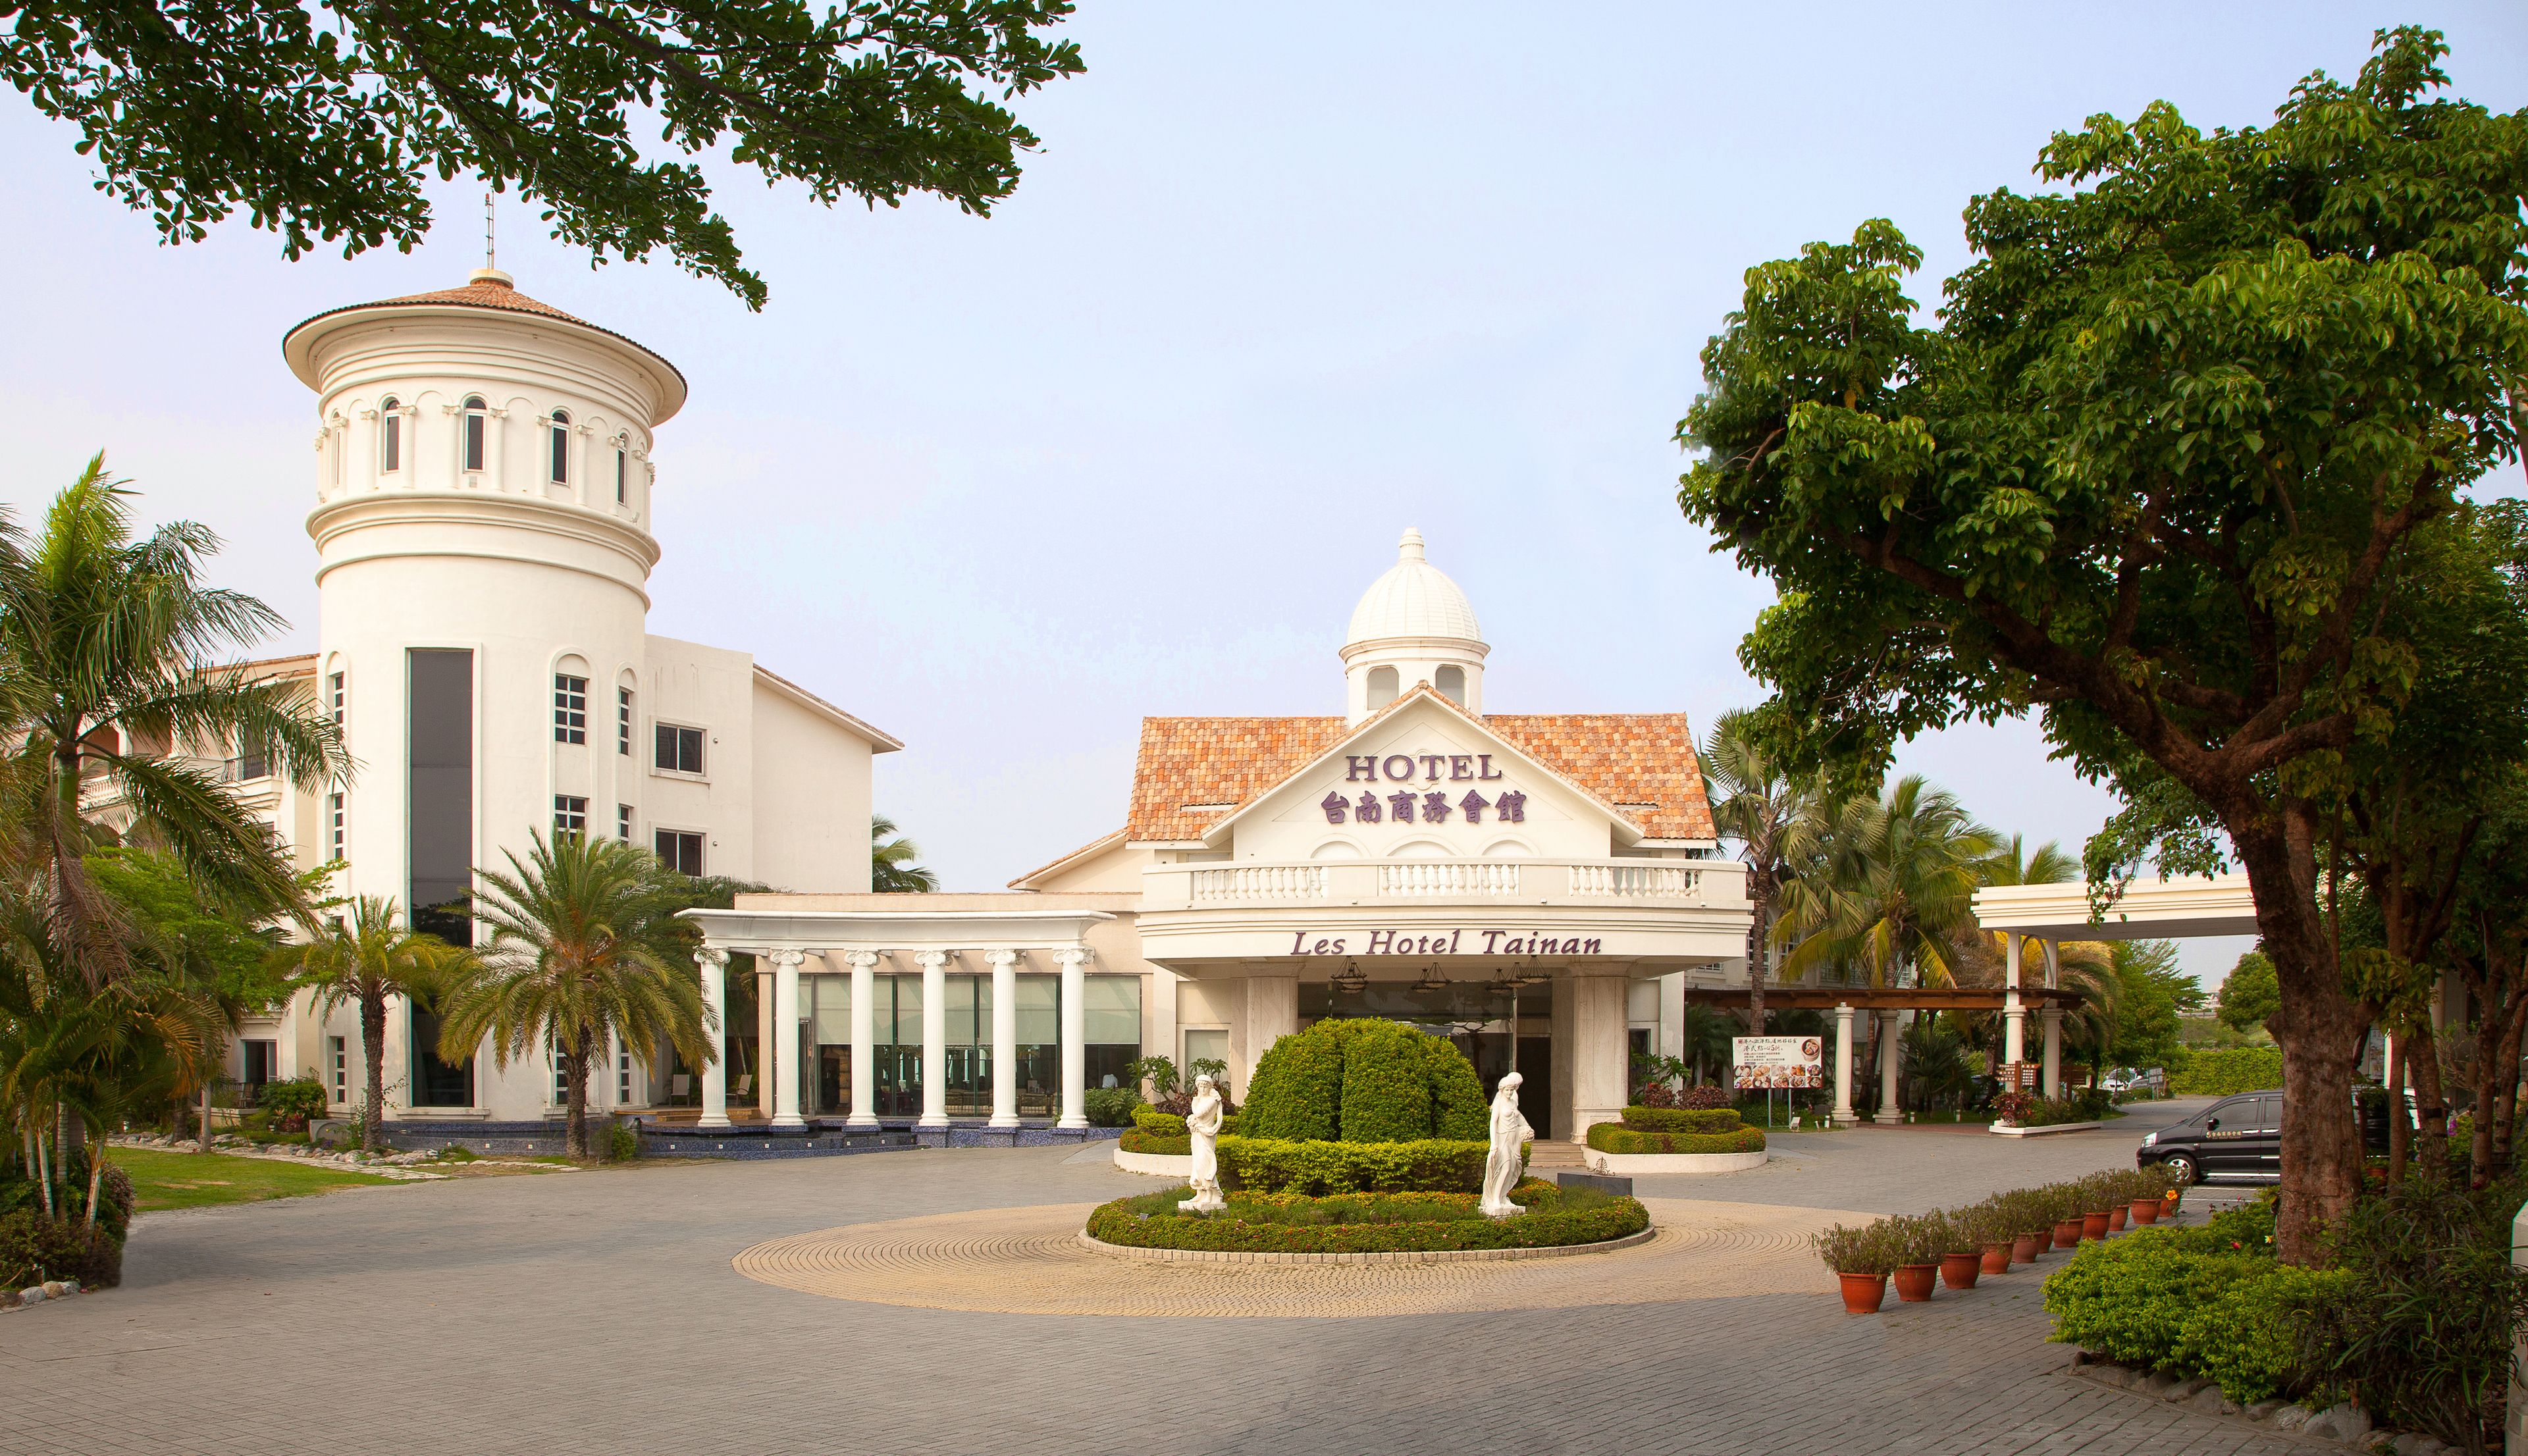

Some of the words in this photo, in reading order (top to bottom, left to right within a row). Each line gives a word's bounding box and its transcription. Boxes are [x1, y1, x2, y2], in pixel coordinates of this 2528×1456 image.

[1346, 754, 1502, 781] HOTEL
[1321, 789, 1527, 824] 台南商務會館
[1290, 931, 1346, 956] Les
[1366, 929, 1462, 955] Hotel
[1482, 930, 1602, 955] Tainan
